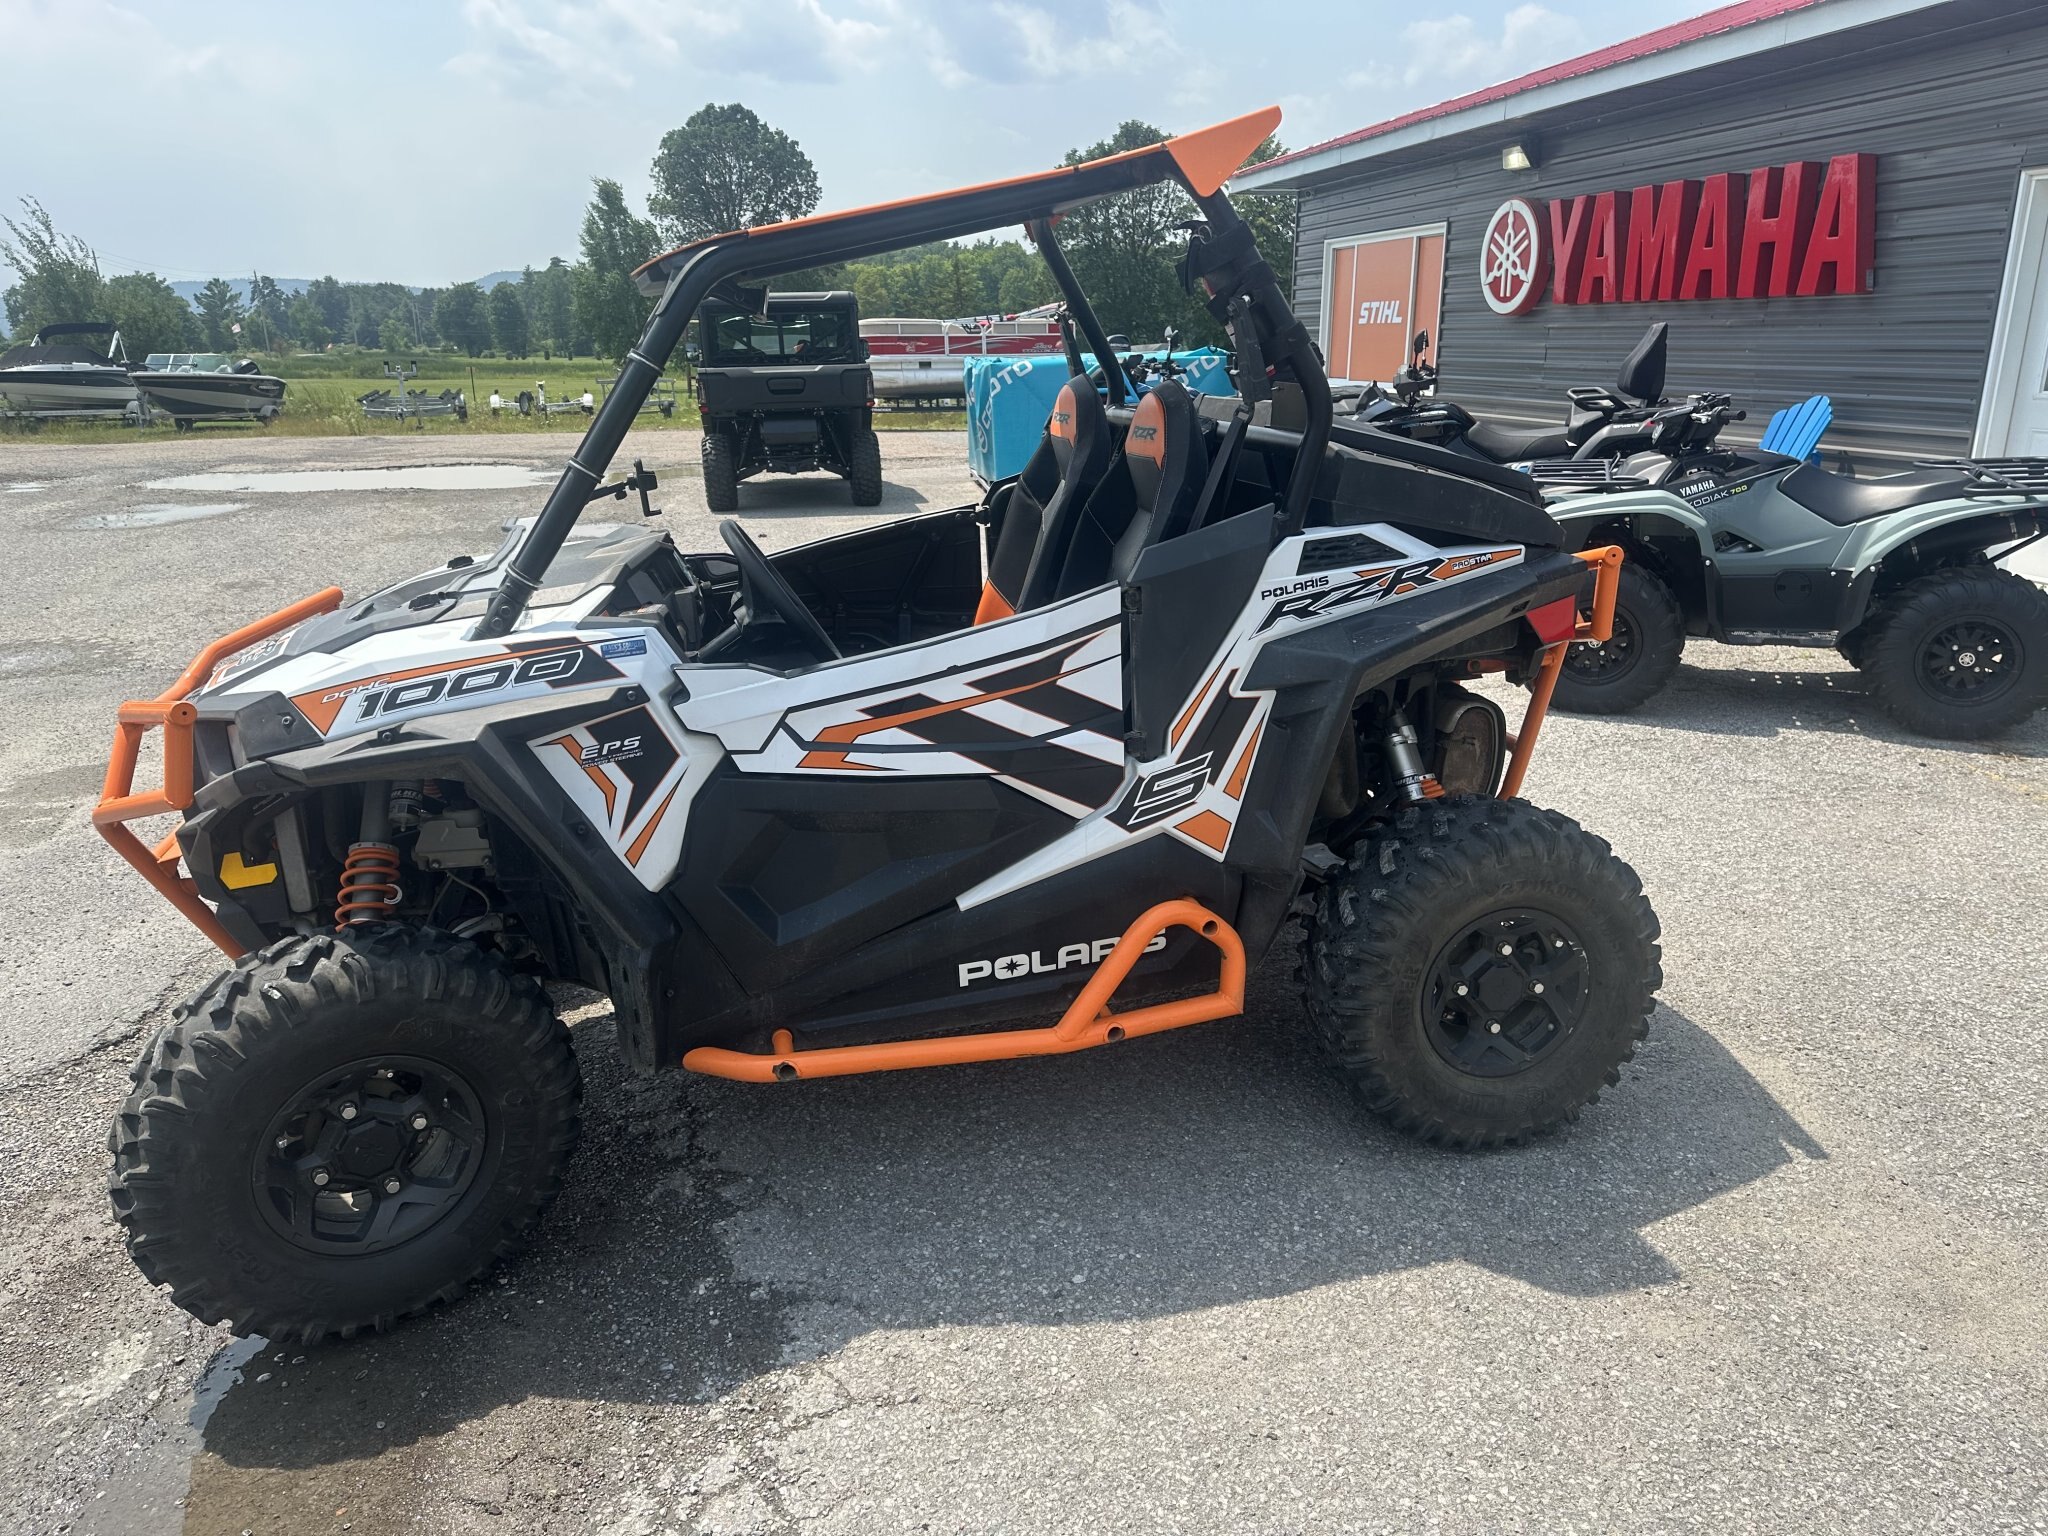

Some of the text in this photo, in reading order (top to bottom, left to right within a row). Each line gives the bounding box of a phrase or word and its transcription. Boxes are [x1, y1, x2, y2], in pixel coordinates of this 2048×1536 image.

[1549, 153, 1876, 305] YAMAHA
[1358, 300, 1403, 325] STIHL
[1053, 412, 1071, 425] RZR
[1132, 425, 1157, 441] RZR
[1679, 479, 1716, 497] YAMAHA
[1729, 484, 1749, 495] 700
[1250, 555, 1451, 641] RZR
[1261, 575, 1330, 601] POLARIS
[321, 676, 392, 704] DOHC
[355, 649, 584, 724] 1000
[580, 735, 642, 760] EPS
